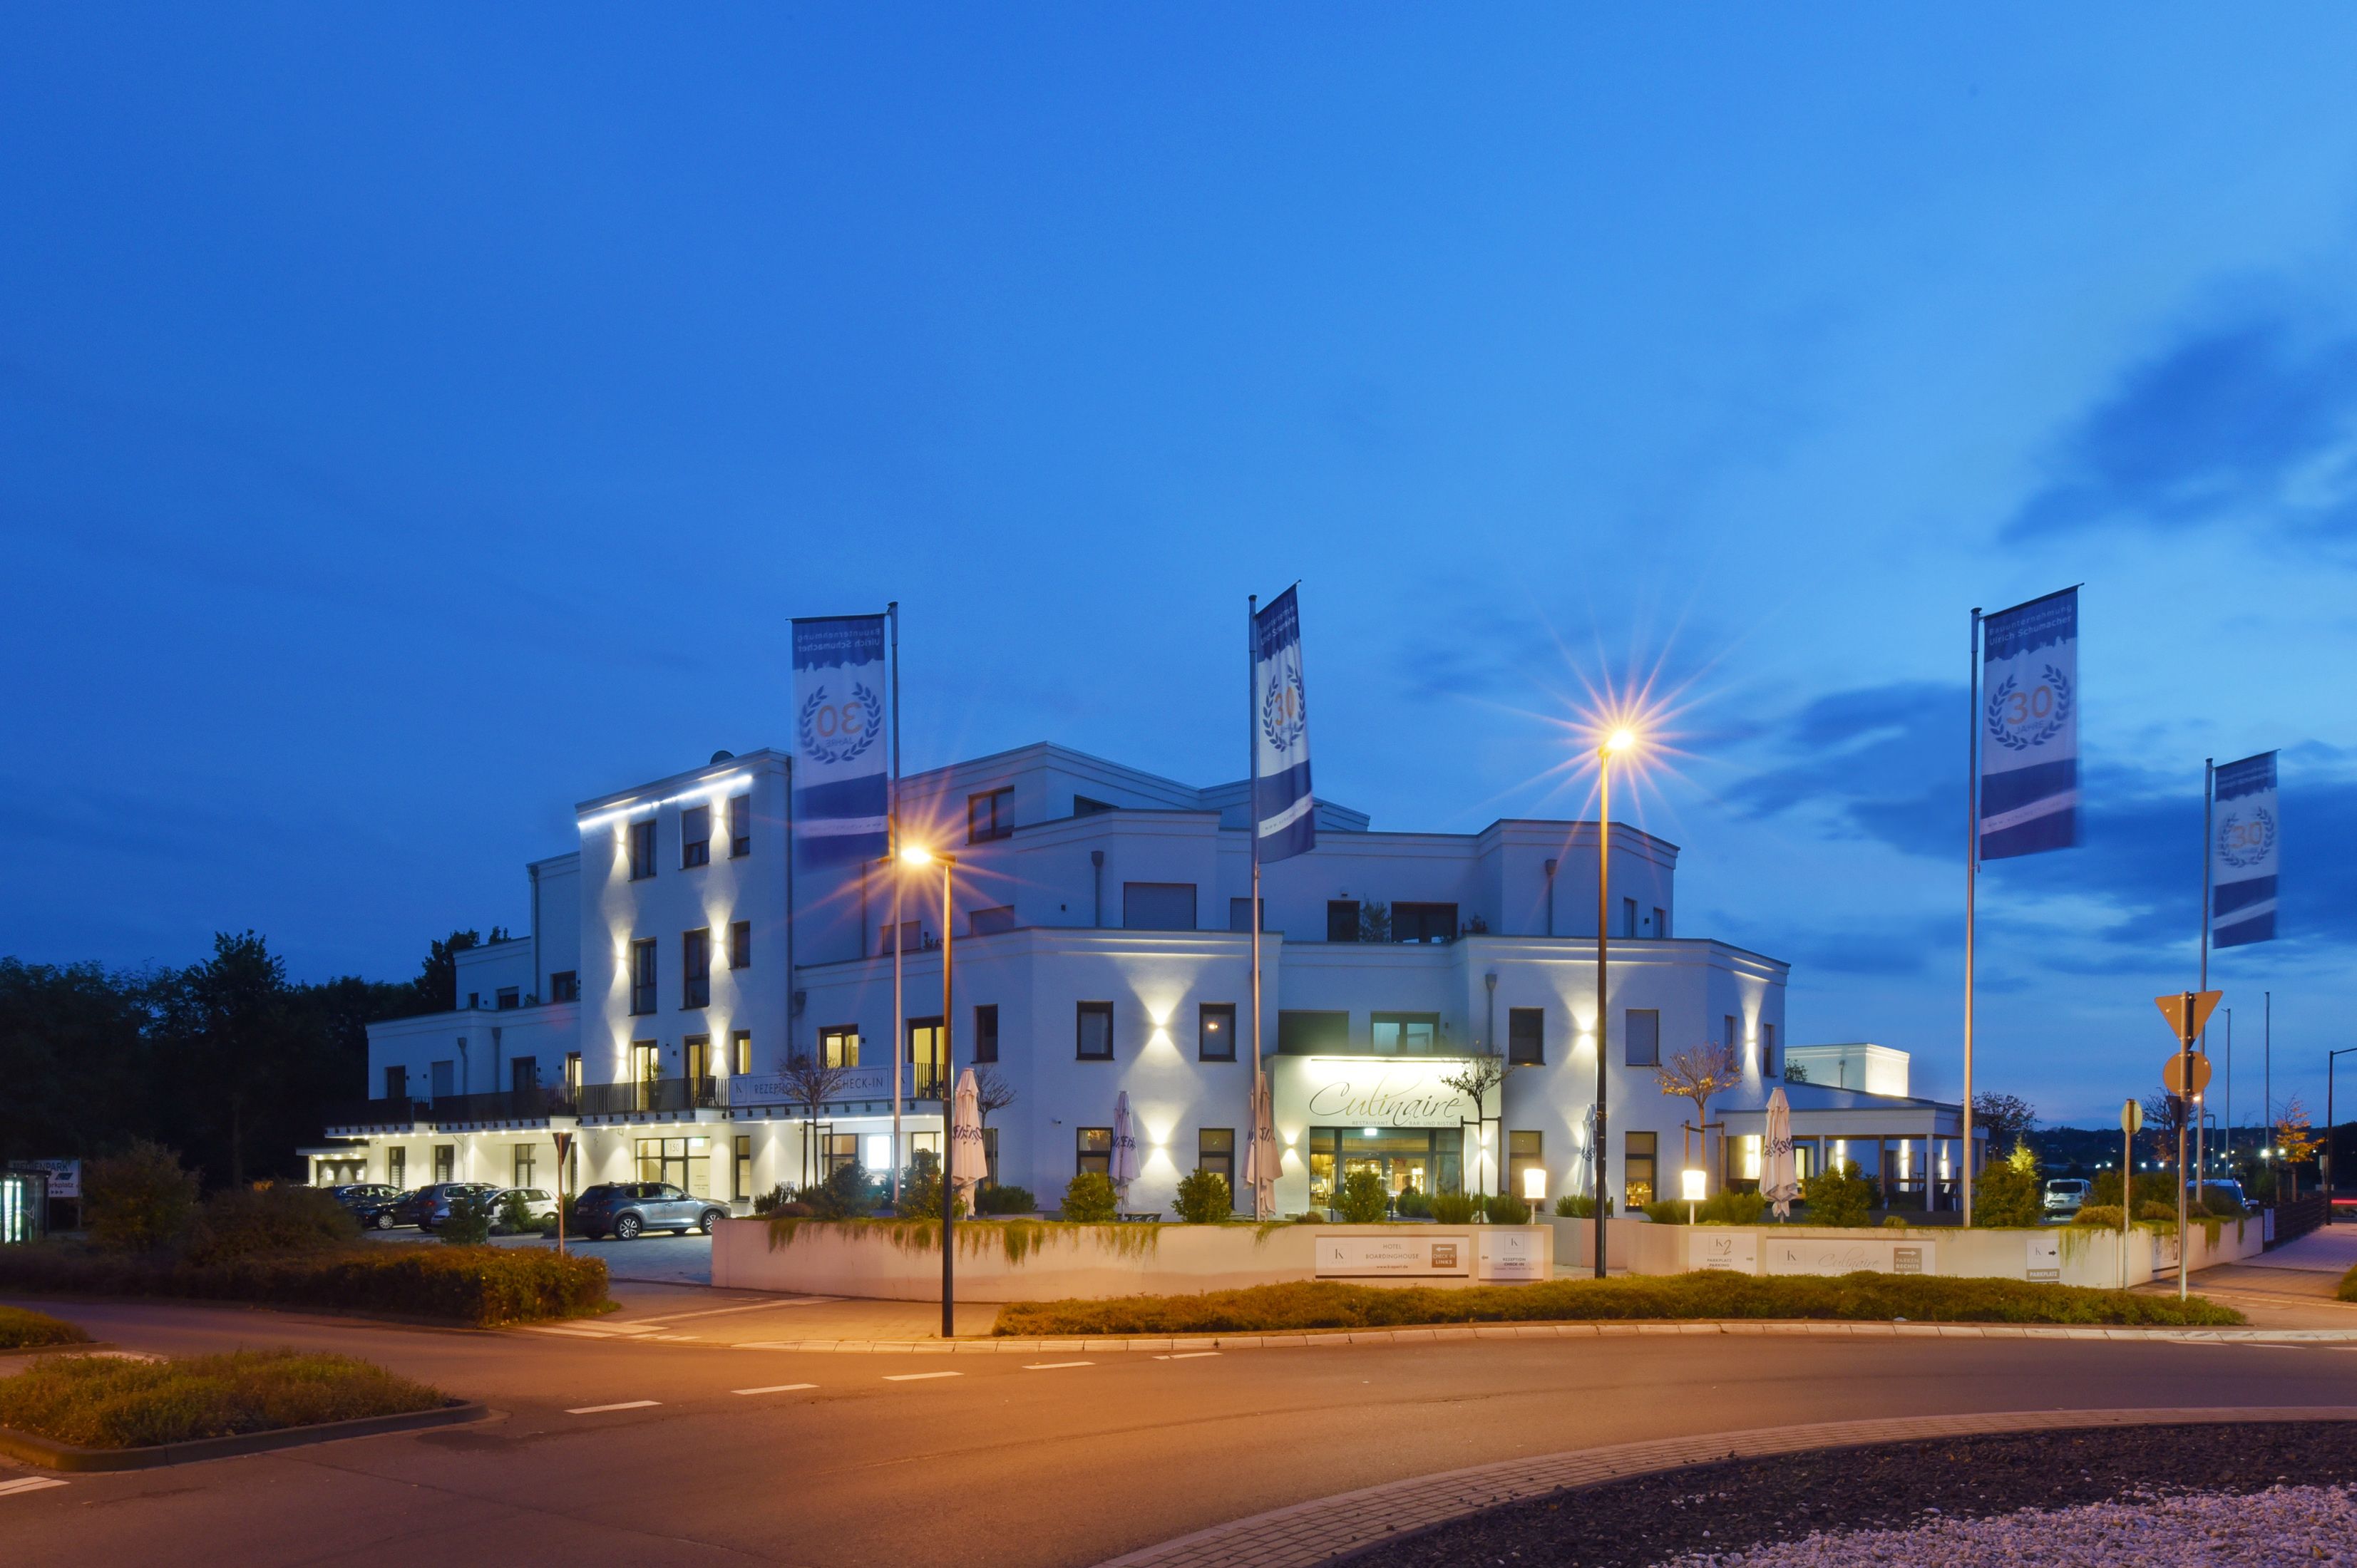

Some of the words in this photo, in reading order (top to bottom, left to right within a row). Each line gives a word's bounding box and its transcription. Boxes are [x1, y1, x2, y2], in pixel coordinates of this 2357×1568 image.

[1988, 604, 2072, 636] Bauunternehmung
[1989, 631, 2015, 646] Ulrich
[2018, 615, 2072, 637] Schumacher
[1275, 686, 1295, 726] 30
[2006, 685, 2053, 725] 30
[2015, 720, 2045, 735] JAHRE
[2230, 821, 2262, 849] 30
[754, 1081, 800, 1095] REZEPTIO
[1309, 1072, 1467, 1126] Culinaire
[669, 1143, 679, 1152] 150
[1818, 1247, 1881, 1272] Culinaire
